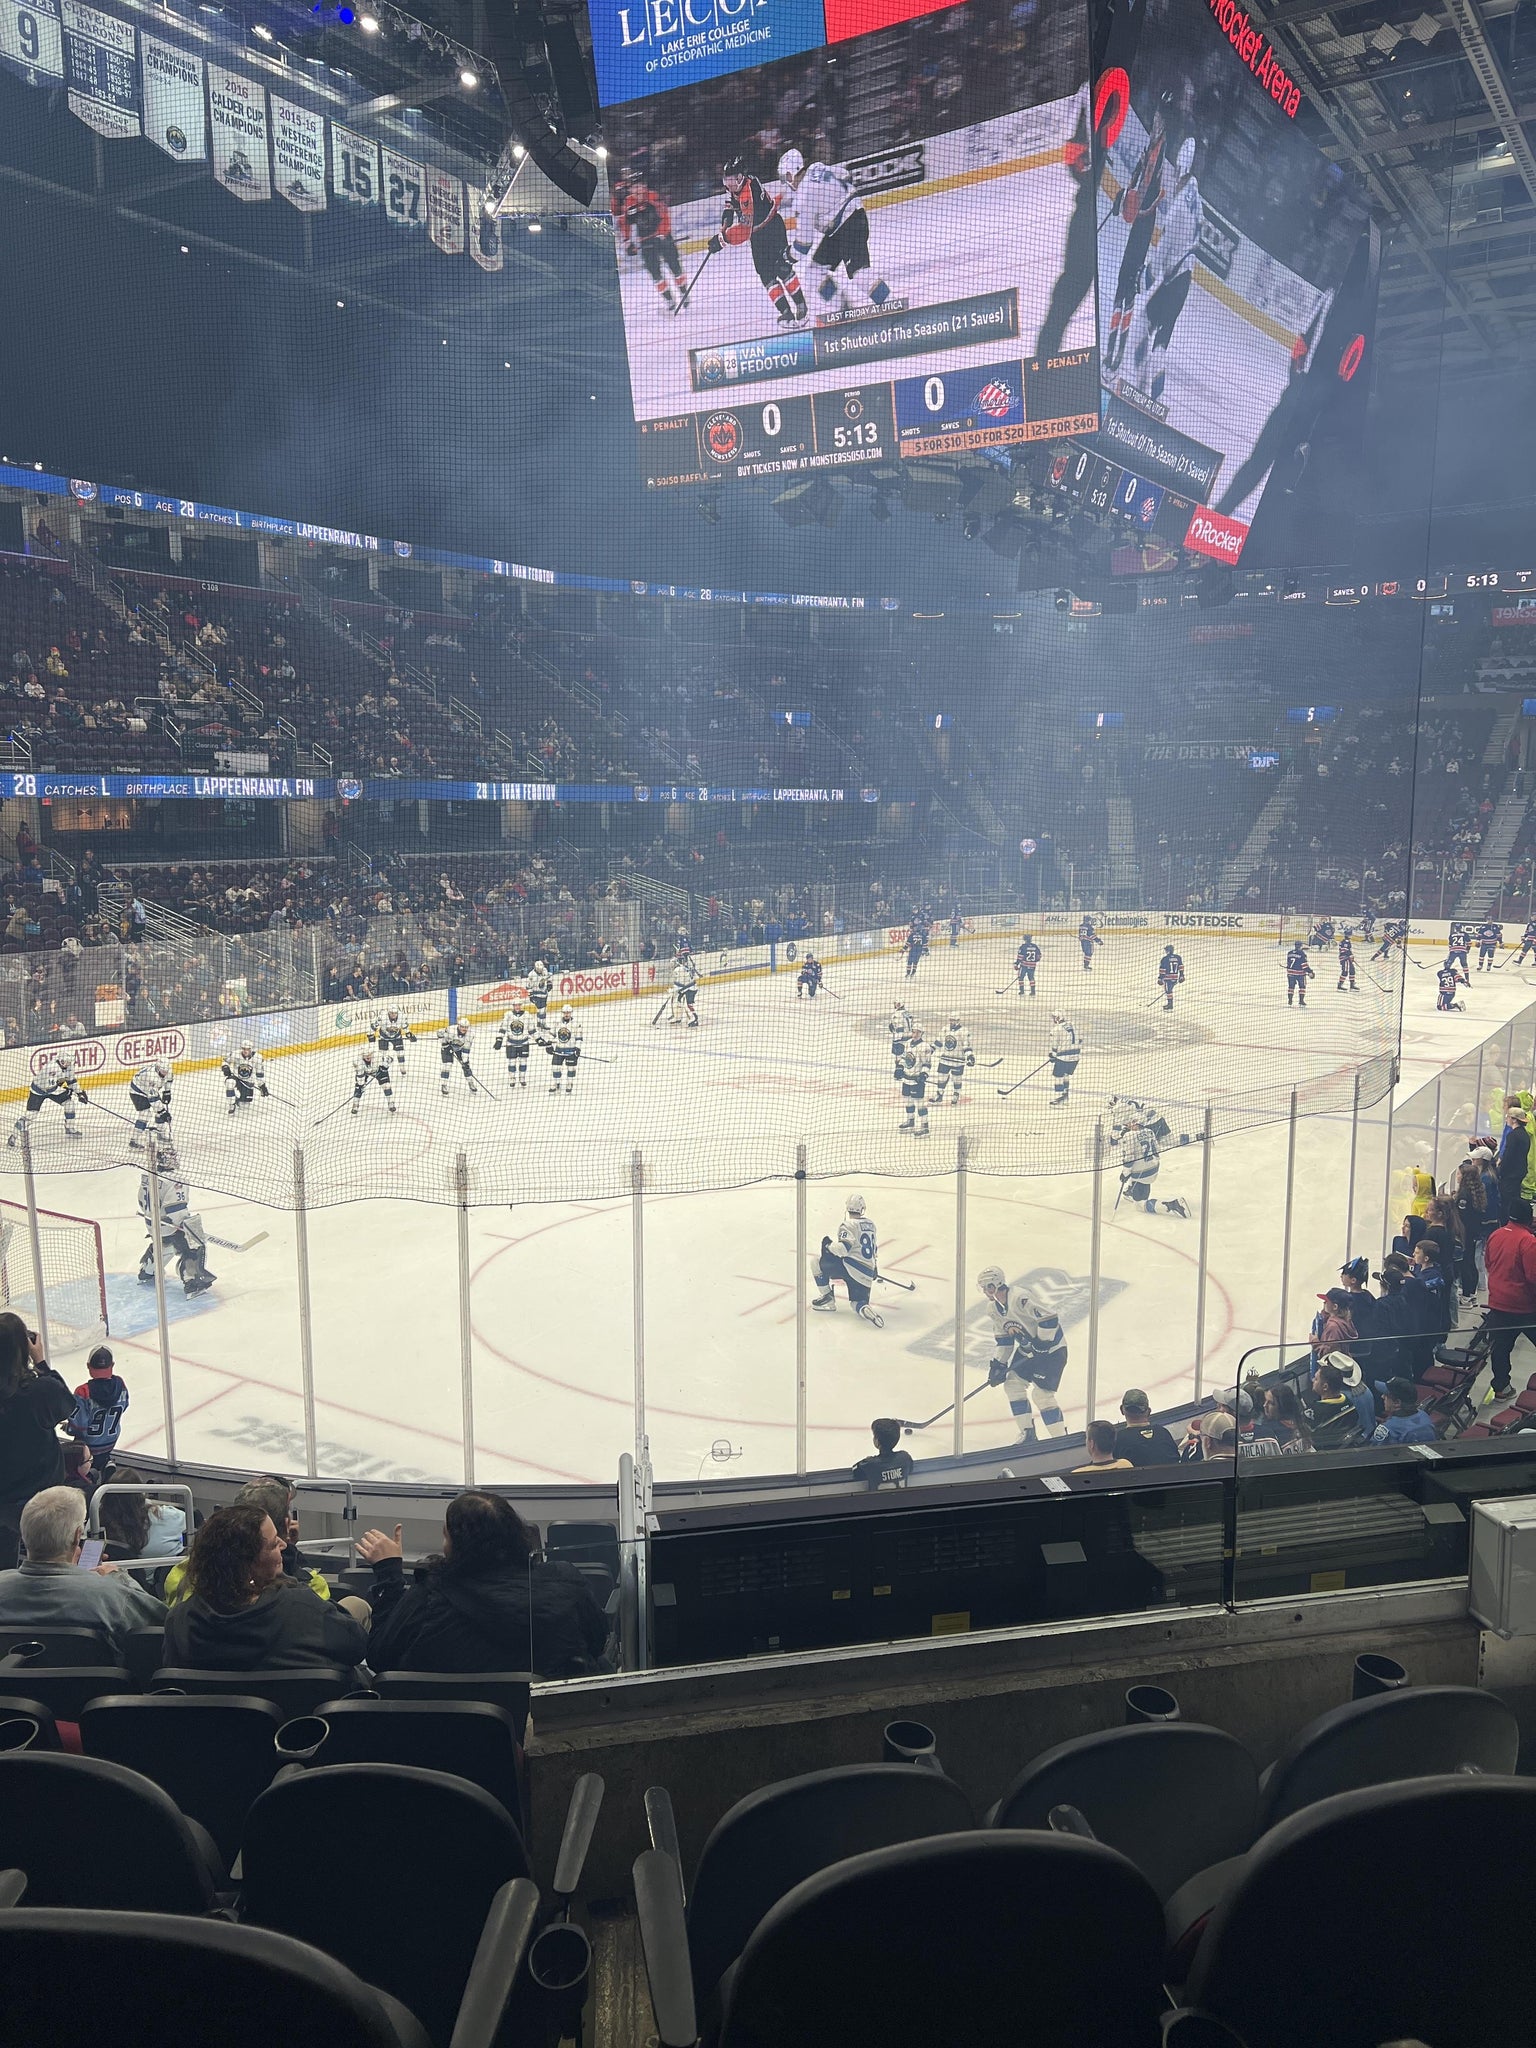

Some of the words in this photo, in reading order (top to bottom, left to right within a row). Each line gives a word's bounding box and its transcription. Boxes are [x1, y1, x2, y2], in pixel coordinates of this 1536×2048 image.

[64, 1, 132, 37] CLEVELAND
[18, 11, 39, 60] 9
[77, 18, 123, 45] BARONS
[661, 40, 685, 55] LAKE
[687, 33, 706, 48] ERIE
[708, 18, 751, 41] COLLEGE
[645, 58, 659, 73] OF
[660, 41, 724, 68] OSTEOPATHIC
[725, 26, 772, 50] MEDICINE
[147, 54, 199, 86] CHAMPIONS
[224, 79, 249, 99] 2016
[1255, 45, 1301, 119] Arena
[211, 91, 244, 116] CALDER
[246, 106, 263, 123] CUP
[213, 109, 263, 140] CHAMPIONS
[280, 107, 316, 133] 2015-16
[281, 125, 316, 150] WESTERN
[276, 137, 322, 166] CONFERENCE
[279, 152, 320, 180] CHAMPIONS
[342, 150, 371, 198] 15
[389, 174, 420, 220] 27
[826, 311, 844, 323] LAST
[844, 306, 870, 319] FRIDAY
[871, 304, 880, 315] AT
[880, 301, 903, 313] UTICA
[824, 340, 839, 354] 1st
[839, 332, 879, 352] Shutout
[880, 329, 892, 343] Of
[893, 326, 912, 341] The
[914, 320, 950, 338] Season
[951, 314, 968, 334] (21
[970, 306, 1004, 328] Saves)
[738, 345, 765, 360] IVAN
[1047, 352, 1090, 370] PENALTY
[725, 357, 737, 370] 28
[740, 354, 798, 376] FEDOTOV
[844, 390, 861, 398] PERIOD
[924, 377, 945, 411] 0
[850, 404, 856, 413] 0
[653, 418, 689, 432] PENALTY
[762, 403, 782, 436] 0
[941, 421, 960, 431] SAVES
[1032, 425, 1048, 437] 125
[1050, 421, 1071, 434] FOR
[1073, 417, 1094, 431] $40
[834, 422, 877, 448] 5:13
[901, 427, 920, 437] SHOTS
[969, 434, 981, 445] 50
[983, 431, 1003, 443] FOR
[1004, 427, 1024, 441] $20
[780, 445, 797, 454] SAVES
[915, 442, 921, 452] 5
[924, 439, 942, 451] FOR
[944, 436, 962, 449] $10
[1107, 418, 1116, 435] 1st
[1115, 422, 1138, 448] Shutout
[1144, 438, 1157, 457] The
[1155, 445, 1177, 469] Season
[1187, 461, 1210, 485] Saves)
[737, 465, 751, 477] BUY
[752, 459, 781, 475] TICKETS
[782, 458, 798, 471] NOW
[800, 457, 808, 469] AT
[1075, 452, 1088, 481] 0
[1090, 489, 1107, 508] 5:13
[1124, 478, 1137, 504] 0
[180, 500, 195, 518] 28
[236, 513, 242, 526] L
[296, 522, 363, 548] LAPPEENRANTA,
[365, 537, 378, 550] FIN
[1201, 521, 1243, 555] Rocket
[1416, 579, 1426, 591] 0
[1466, 573, 1498, 587] 5:13
[700, 589, 712, 600] 28
[742, 592, 747, 603] L
[791, 594, 849, 608] LAPPEENRANTA,
[852, 596, 864, 607] FIN
[1333, 588, 1355, 597] SAVES
[1361, 586, 1368, 596] 0
[13, 774, 36, 796] 28
[102, 778, 111, 796] L
[194, 777, 292, 797] LAPPEENRANTA,
[296, 778, 314, 796] FIN
[502, 783, 520, 800] IVAN
[699, 788, 708, 800] 28
[773, 789, 830, 802] LAPPEENRANTA,
[832, 789, 844, 800] FIN
[1104, 916, 1148, 928] Technologies
[1164, 915, 1243, 927] TRUSTEDSEC
[1452, 937, 1464, 946] 24
[1026, 951, 1036, 961] 23
[1289, 958, 1296, 968] 7
[1170, 962, 1178, 973] 17
[575, 967, 626, 993] Rocket
[1442, 977, 1454, 987] 39
[88, 1406, 122, 1436] 97
[882, 1468, 902, 1481] STONE
